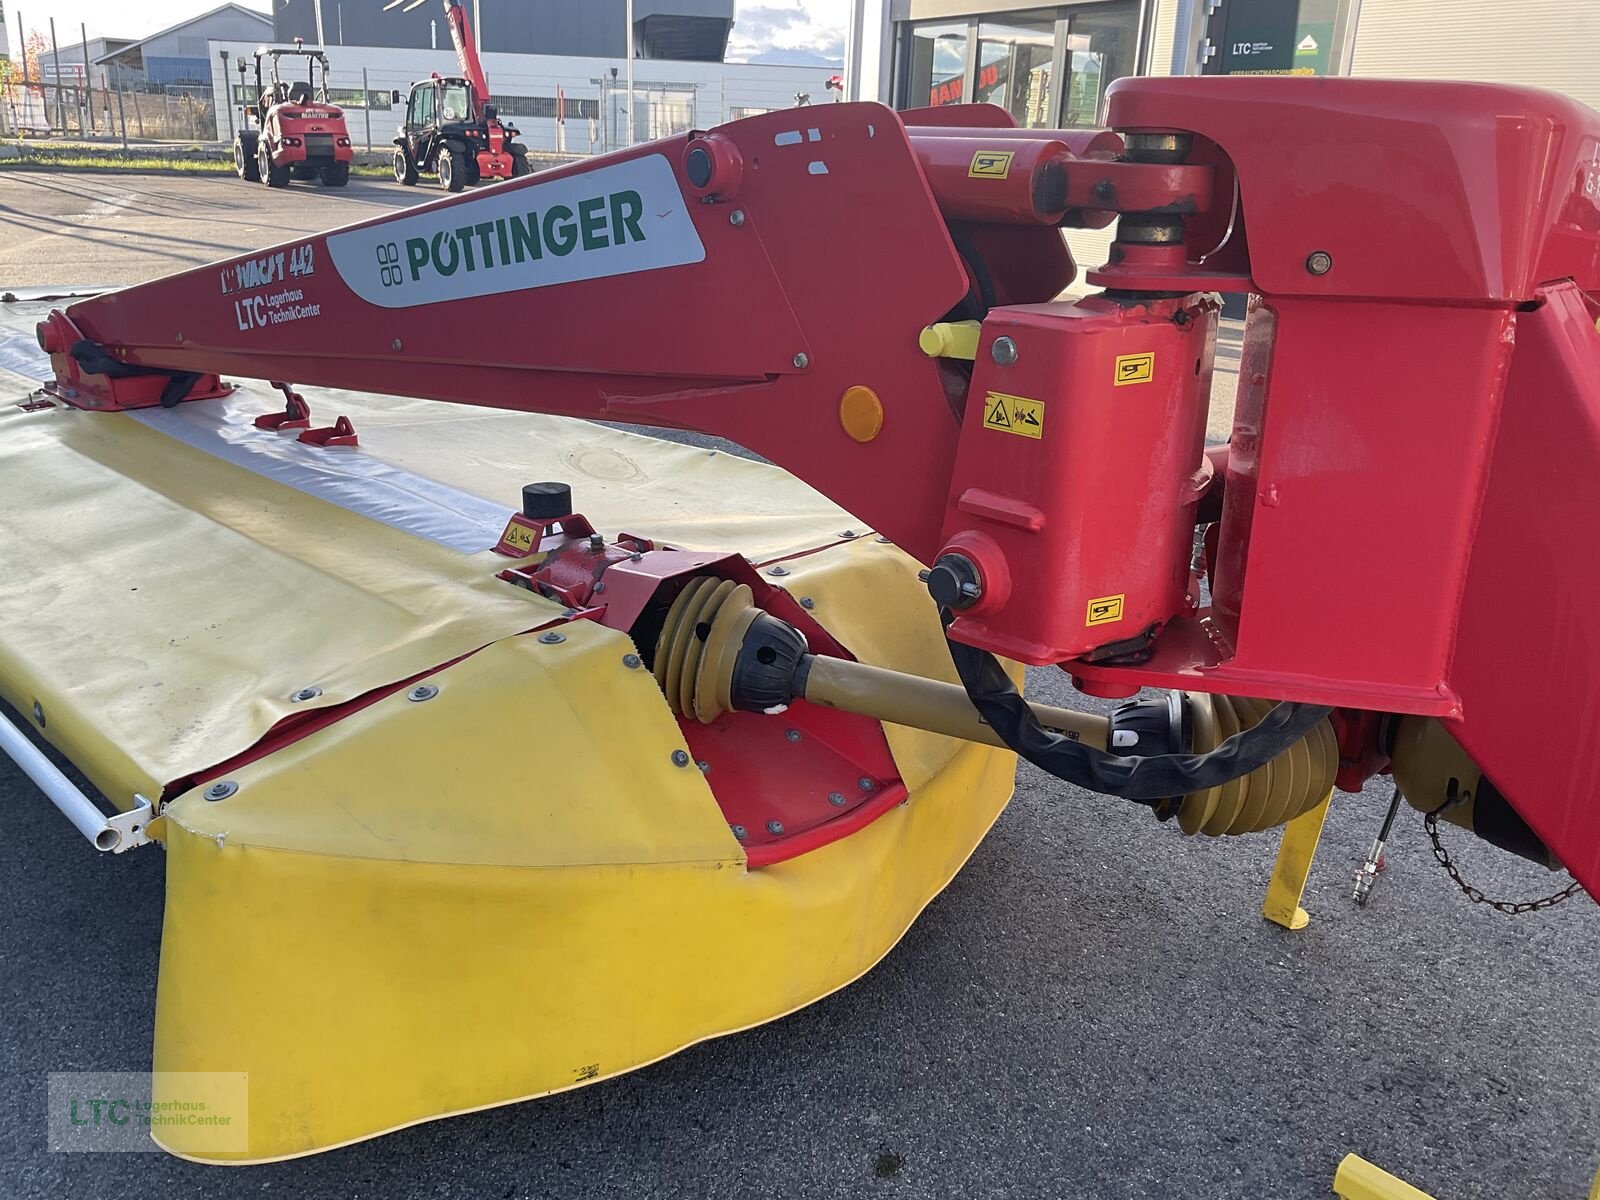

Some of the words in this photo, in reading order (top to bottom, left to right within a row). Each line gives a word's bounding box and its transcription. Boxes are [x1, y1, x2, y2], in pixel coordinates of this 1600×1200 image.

[1232, 43, 1251, 55] LTC
[289, 244, 315, 277] 442
[266, 289, 304, 308] Lagerhaus
[235, 296, 267, 331] LTC
[268, 304, 321, 324] TechnikCenter
